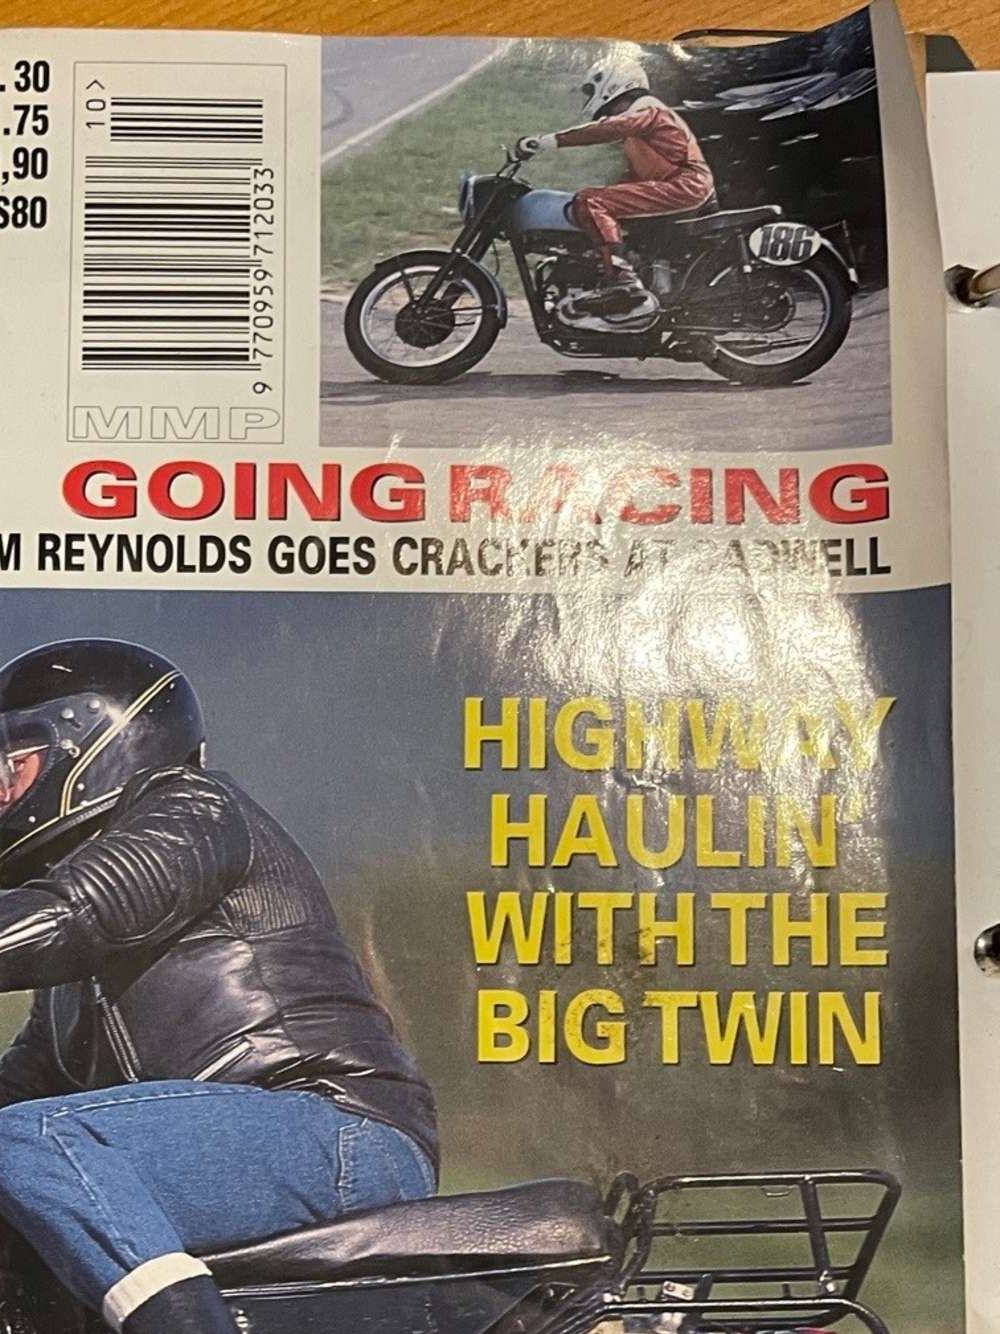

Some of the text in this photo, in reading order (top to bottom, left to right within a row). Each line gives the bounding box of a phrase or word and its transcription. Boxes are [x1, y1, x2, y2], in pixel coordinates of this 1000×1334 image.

[14, 60, 51, 93] 30
[759, 226, 815, 261] 186
[72, 406, 281, 440] MMP
[62, 459, 427, 523] GOING
[37, 533, 252, 574] REYNOLDS
[267, 535, 377, 575] GOES
[693, 537, 892, 577] ADWELL
[464, 695, 897, 771] HIGHWAY
[466, 891, 889, 967] WITH THE
[477, 989, 883, 1066] BIG TWIN
